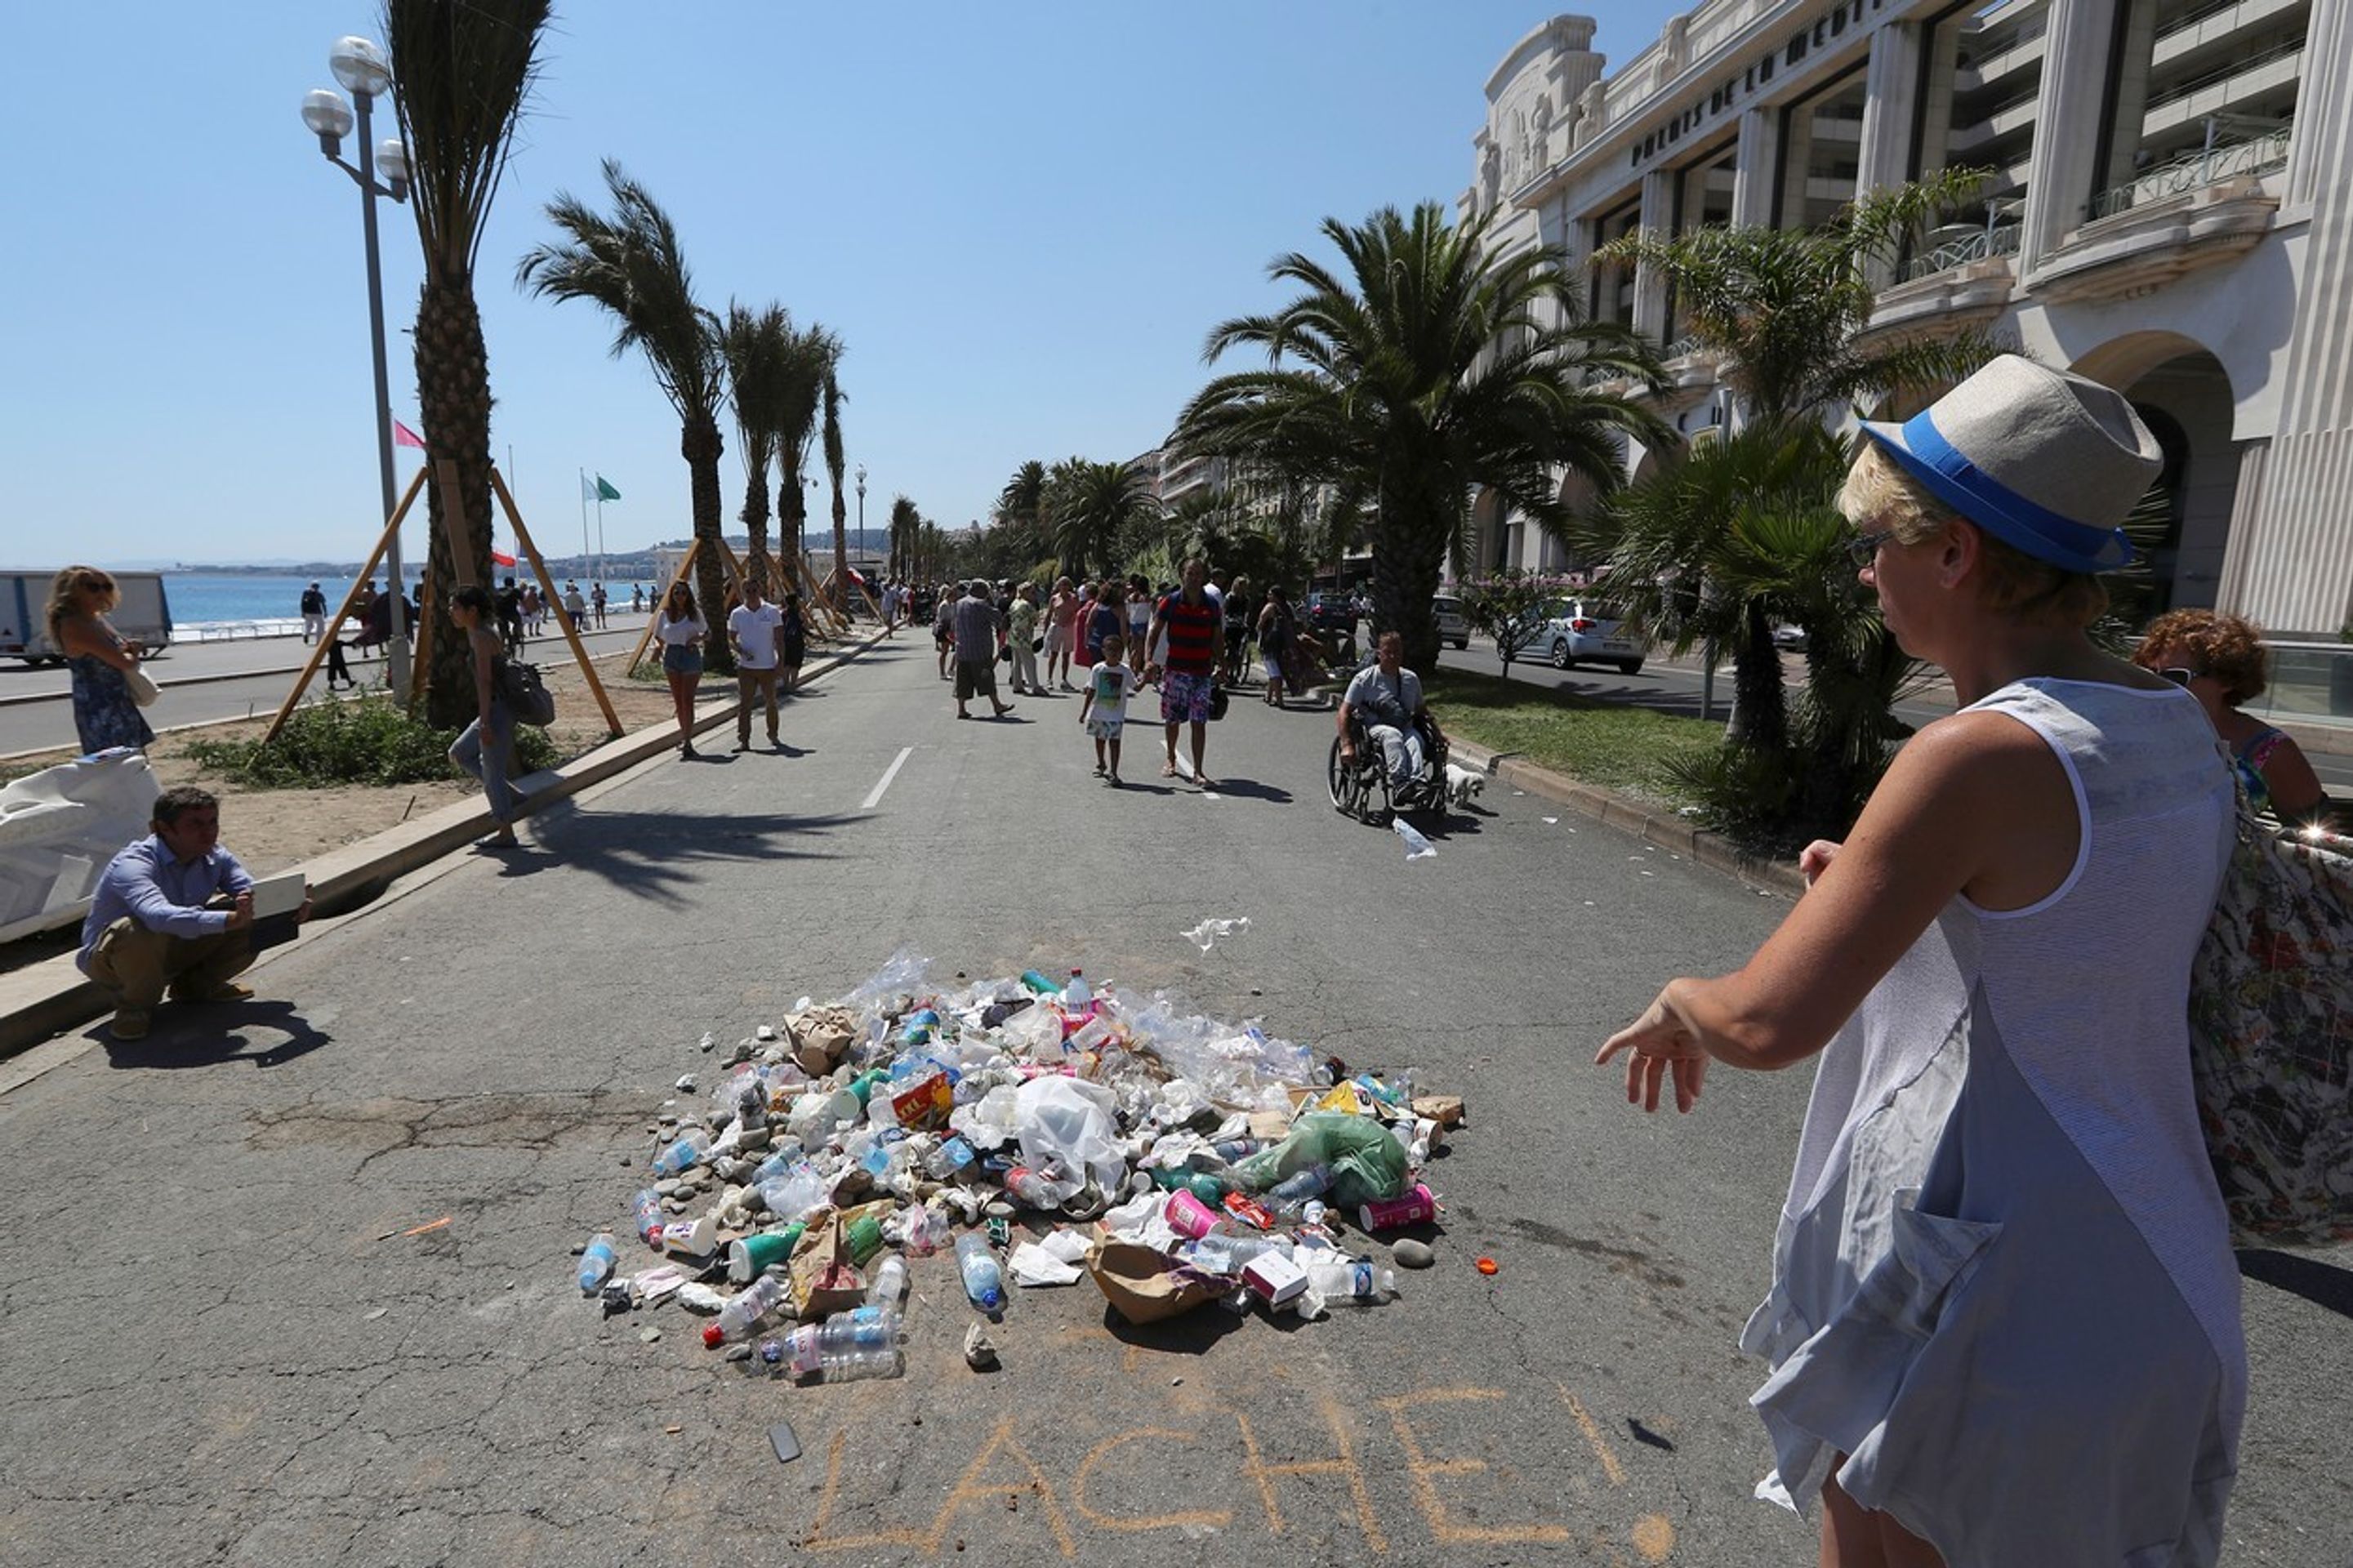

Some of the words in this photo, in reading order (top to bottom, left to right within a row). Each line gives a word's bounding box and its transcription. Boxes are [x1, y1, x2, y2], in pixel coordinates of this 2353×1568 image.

[1631, 100, 1705, 167] PALAIS
[1710, 79, 1736, 115] DE
[1745, 54, 1775, 92] LA
